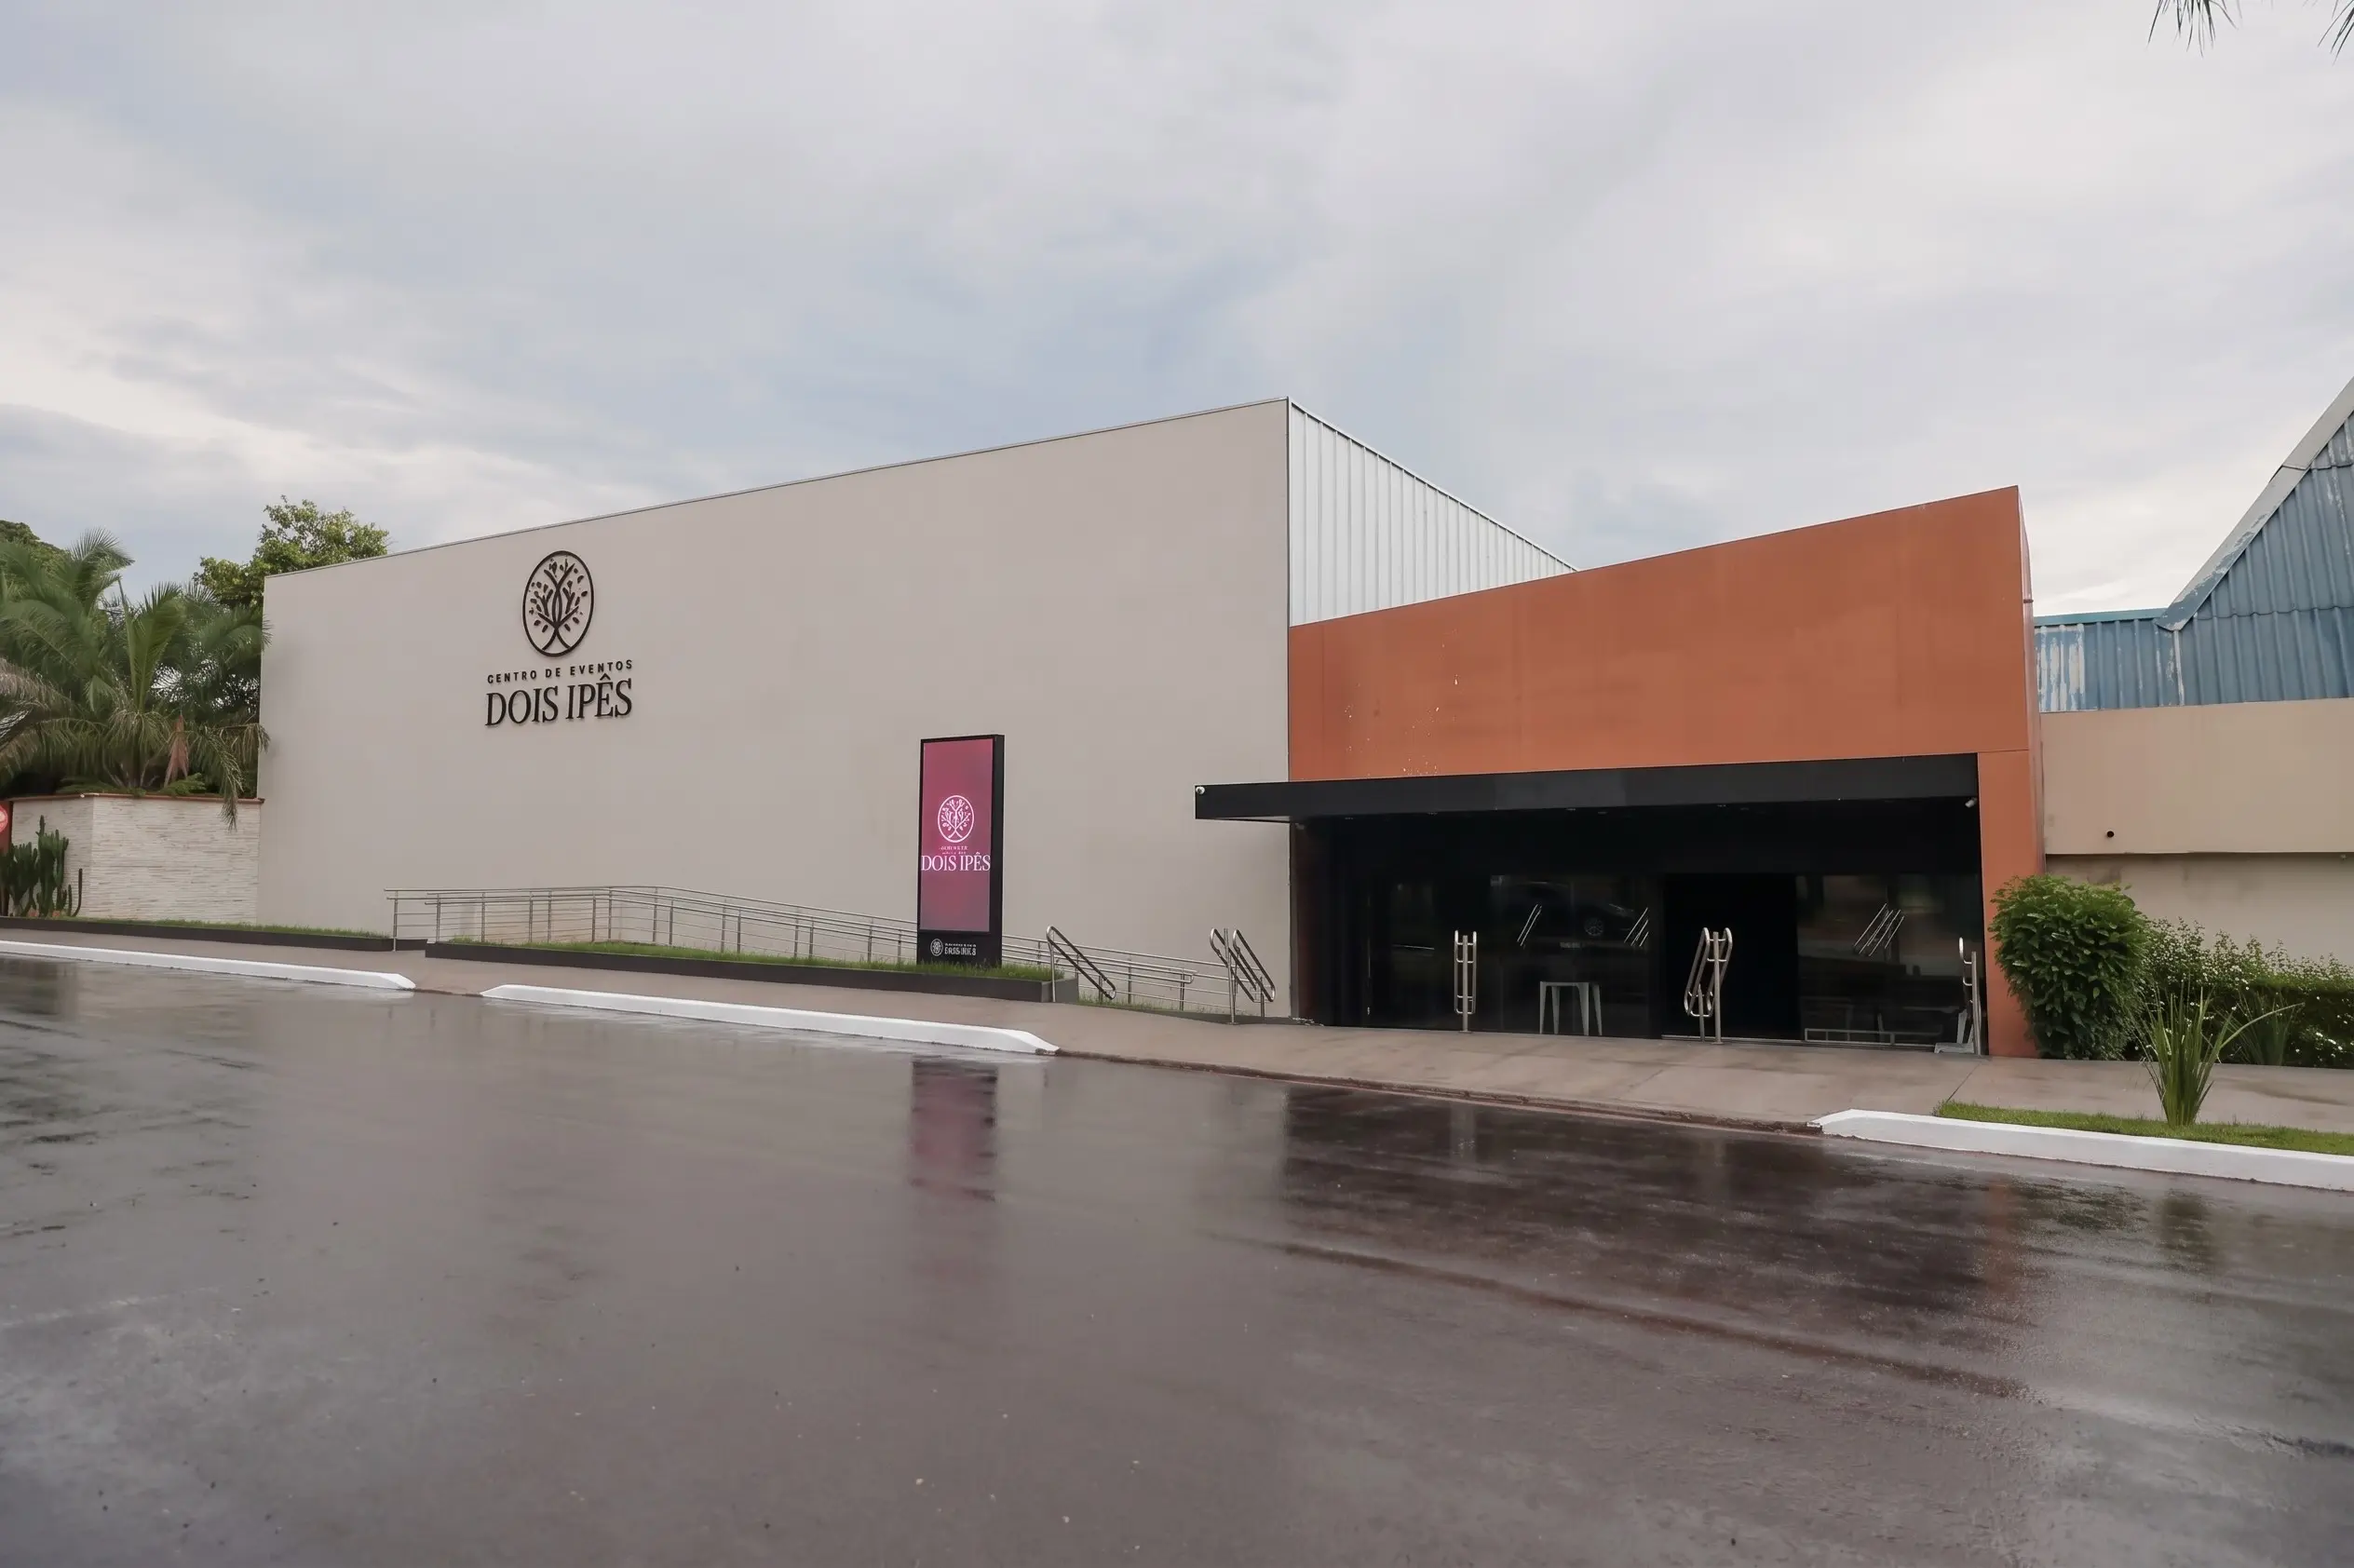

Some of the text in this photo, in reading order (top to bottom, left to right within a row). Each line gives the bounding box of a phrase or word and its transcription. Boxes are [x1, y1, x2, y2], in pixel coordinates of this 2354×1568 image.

[487, 659, 633, 684] CENTRO DE EVENTOS
[485, 672, 633, 726] DOIS IPÊS
[921, 851, 991, 872] DOIS IPÊS
